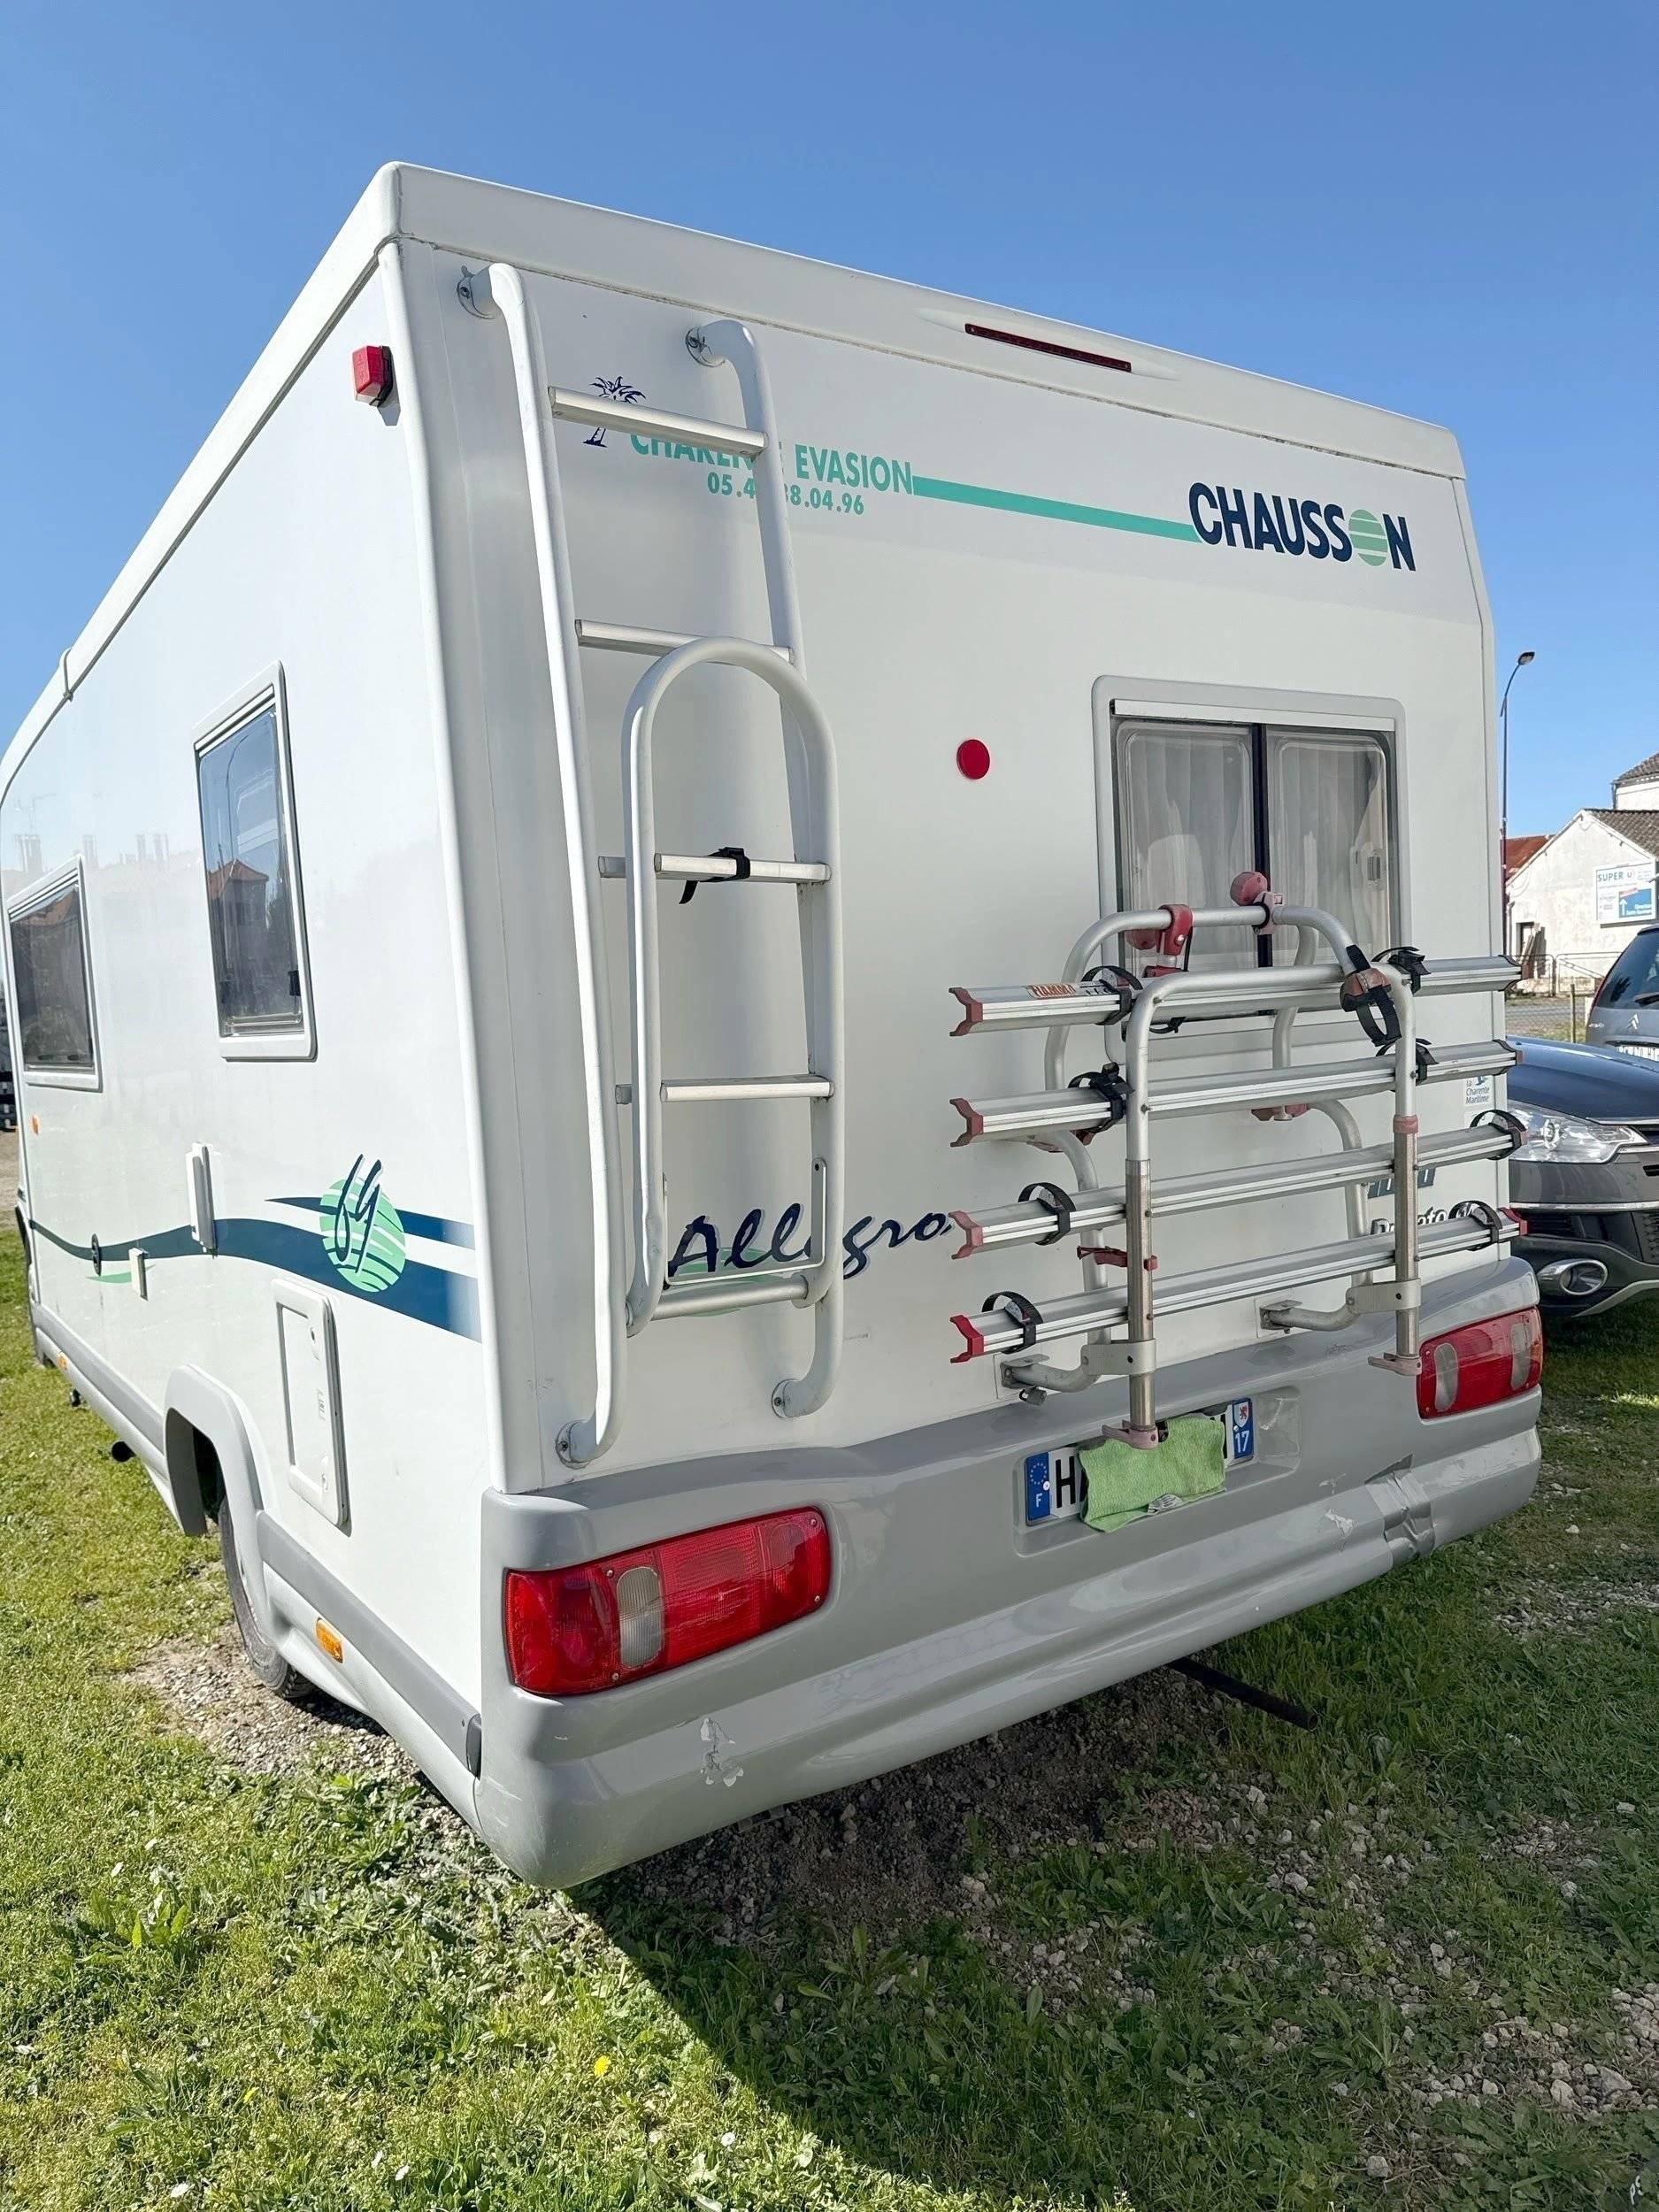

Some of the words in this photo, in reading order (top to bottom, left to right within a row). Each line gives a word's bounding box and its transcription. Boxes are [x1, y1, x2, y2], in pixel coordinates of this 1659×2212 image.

[630, 433, 784, 475] CHAR
[795, 443, 914, 495] EVASION
[707, 472, 864, 516] 05.48.04.96
[1188, 482, 1417, 572] CHAUSSON
[1598, 872, 1624, 882] SUPER
[668, 1202, 952, 1280] Allgro
[1234, 1430, 1250, 1454] 17
[1035, 1492, 1043, 1508] F
